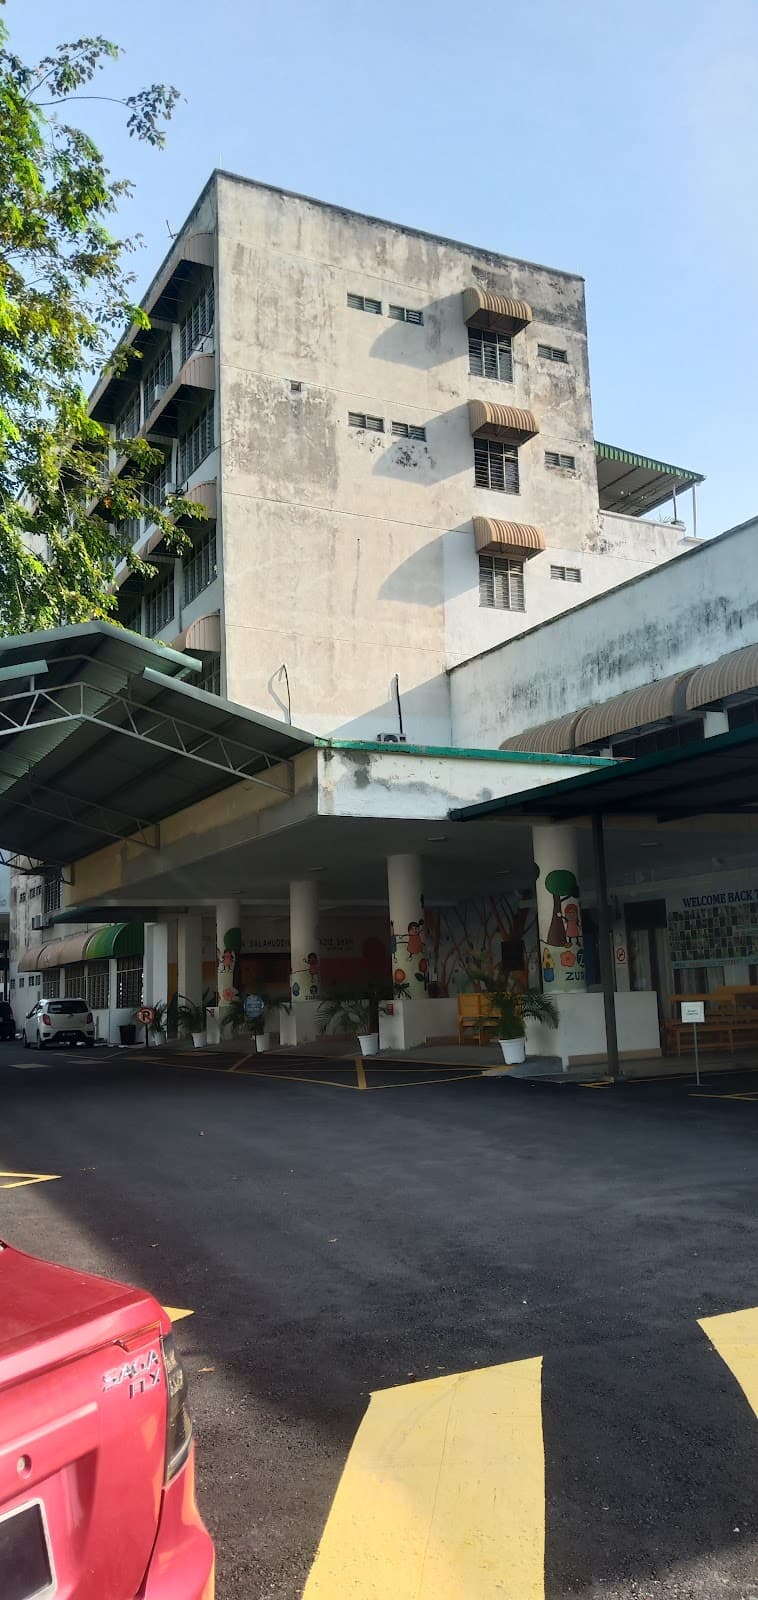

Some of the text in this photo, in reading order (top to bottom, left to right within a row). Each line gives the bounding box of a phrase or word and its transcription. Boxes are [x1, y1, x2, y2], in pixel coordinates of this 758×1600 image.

[683, 893, 726, 908] WELCOME
[727, 889, 752, 903] BACK
[102, 1351, 159, 1392] SAGA
